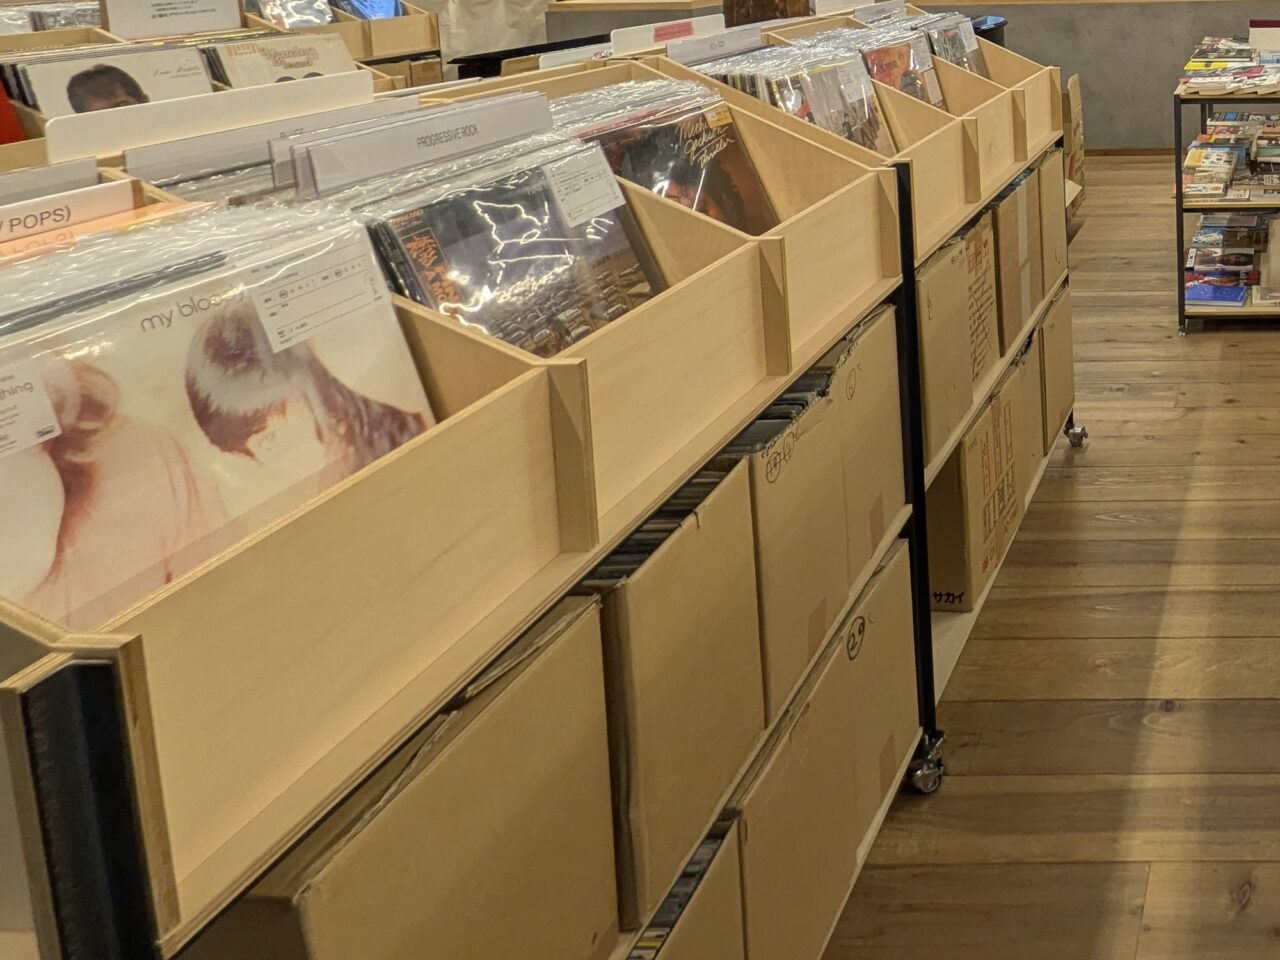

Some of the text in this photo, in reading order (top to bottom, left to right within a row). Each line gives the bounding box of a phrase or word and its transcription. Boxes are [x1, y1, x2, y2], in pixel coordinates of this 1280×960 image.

[9, 205, 71, 233] POPS)
[140, 309, 173, 333] my
[932, 591, 965, 604] サカイ
